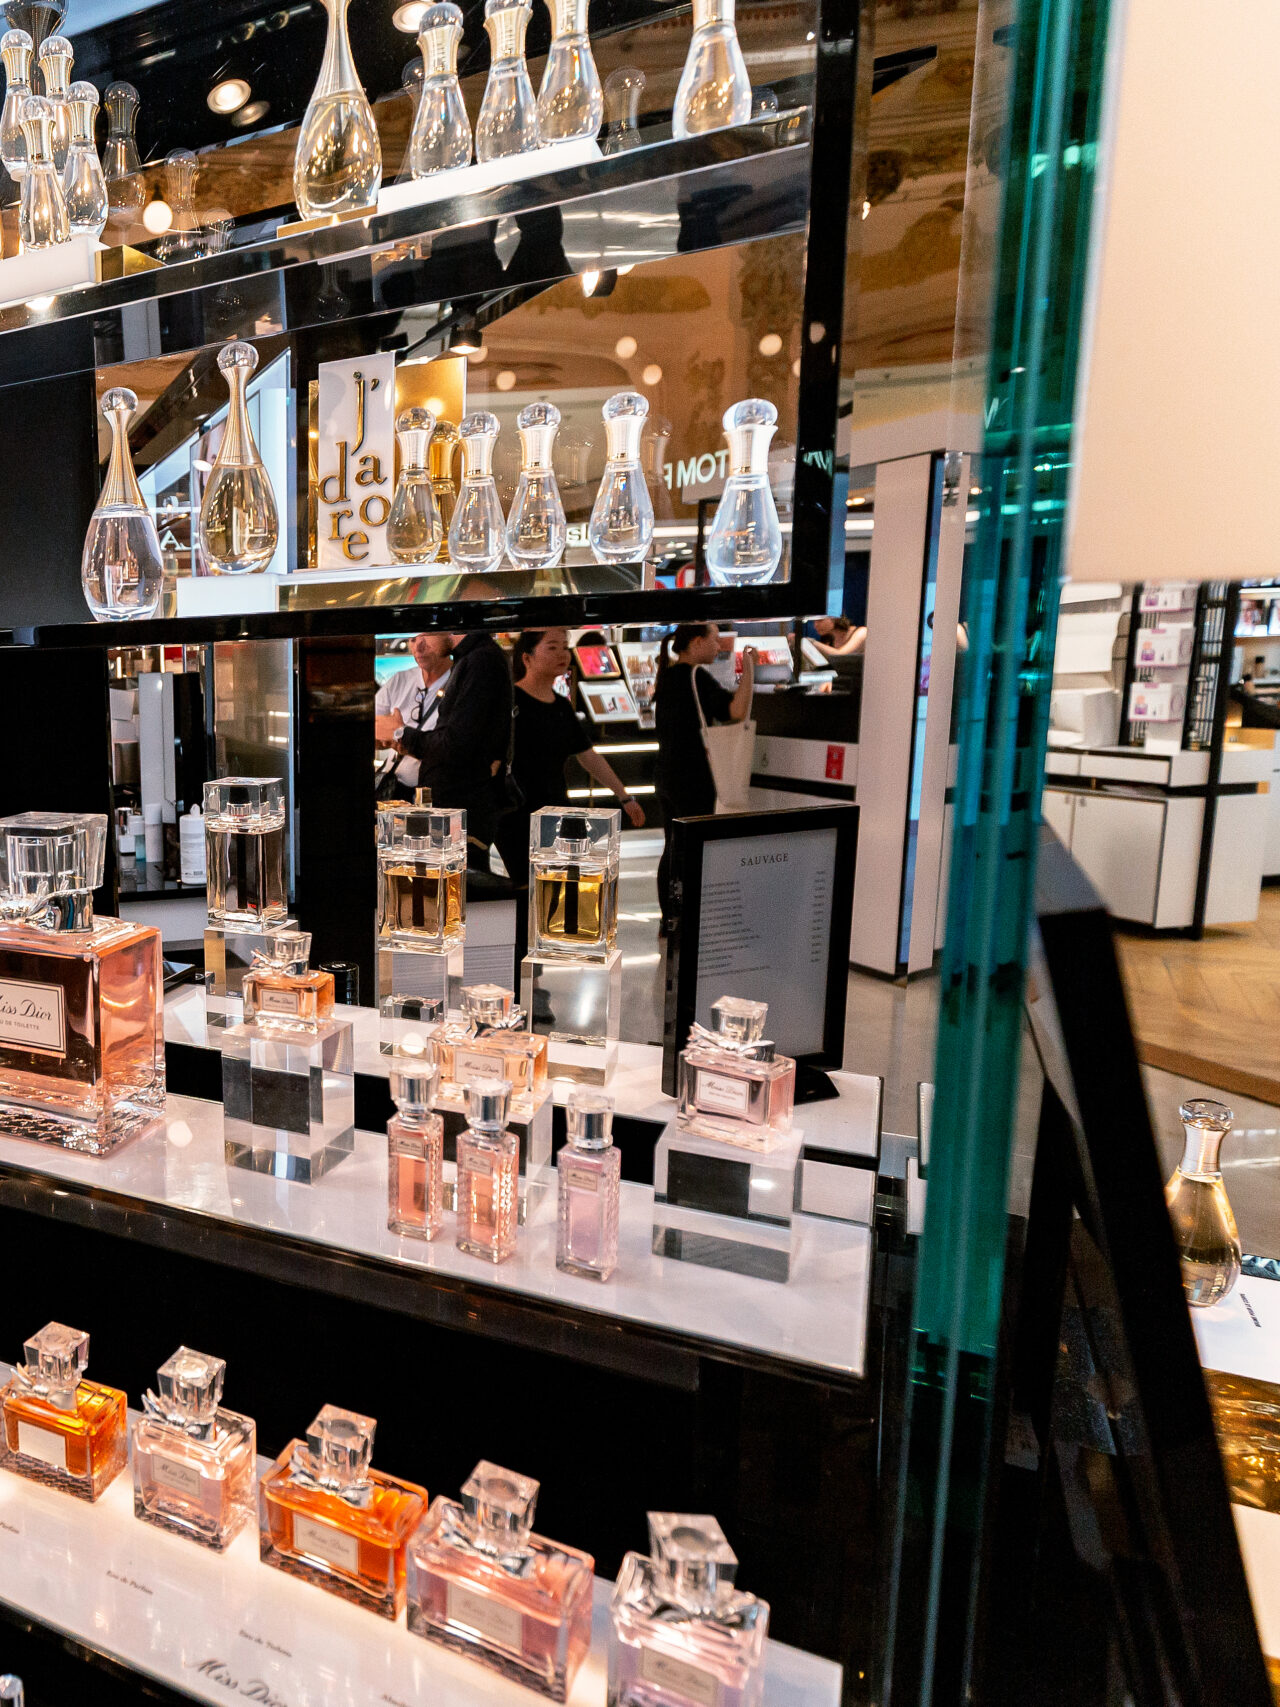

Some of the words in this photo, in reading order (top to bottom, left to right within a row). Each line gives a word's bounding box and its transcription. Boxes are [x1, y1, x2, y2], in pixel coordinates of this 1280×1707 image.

[740, 853, 789, 867] SAUVAGE
[19, 999, 52, 1021] Dior
[14, 1021, 40, 1031] TOILETTE
[186, 1658, 238, 1689] Miss
